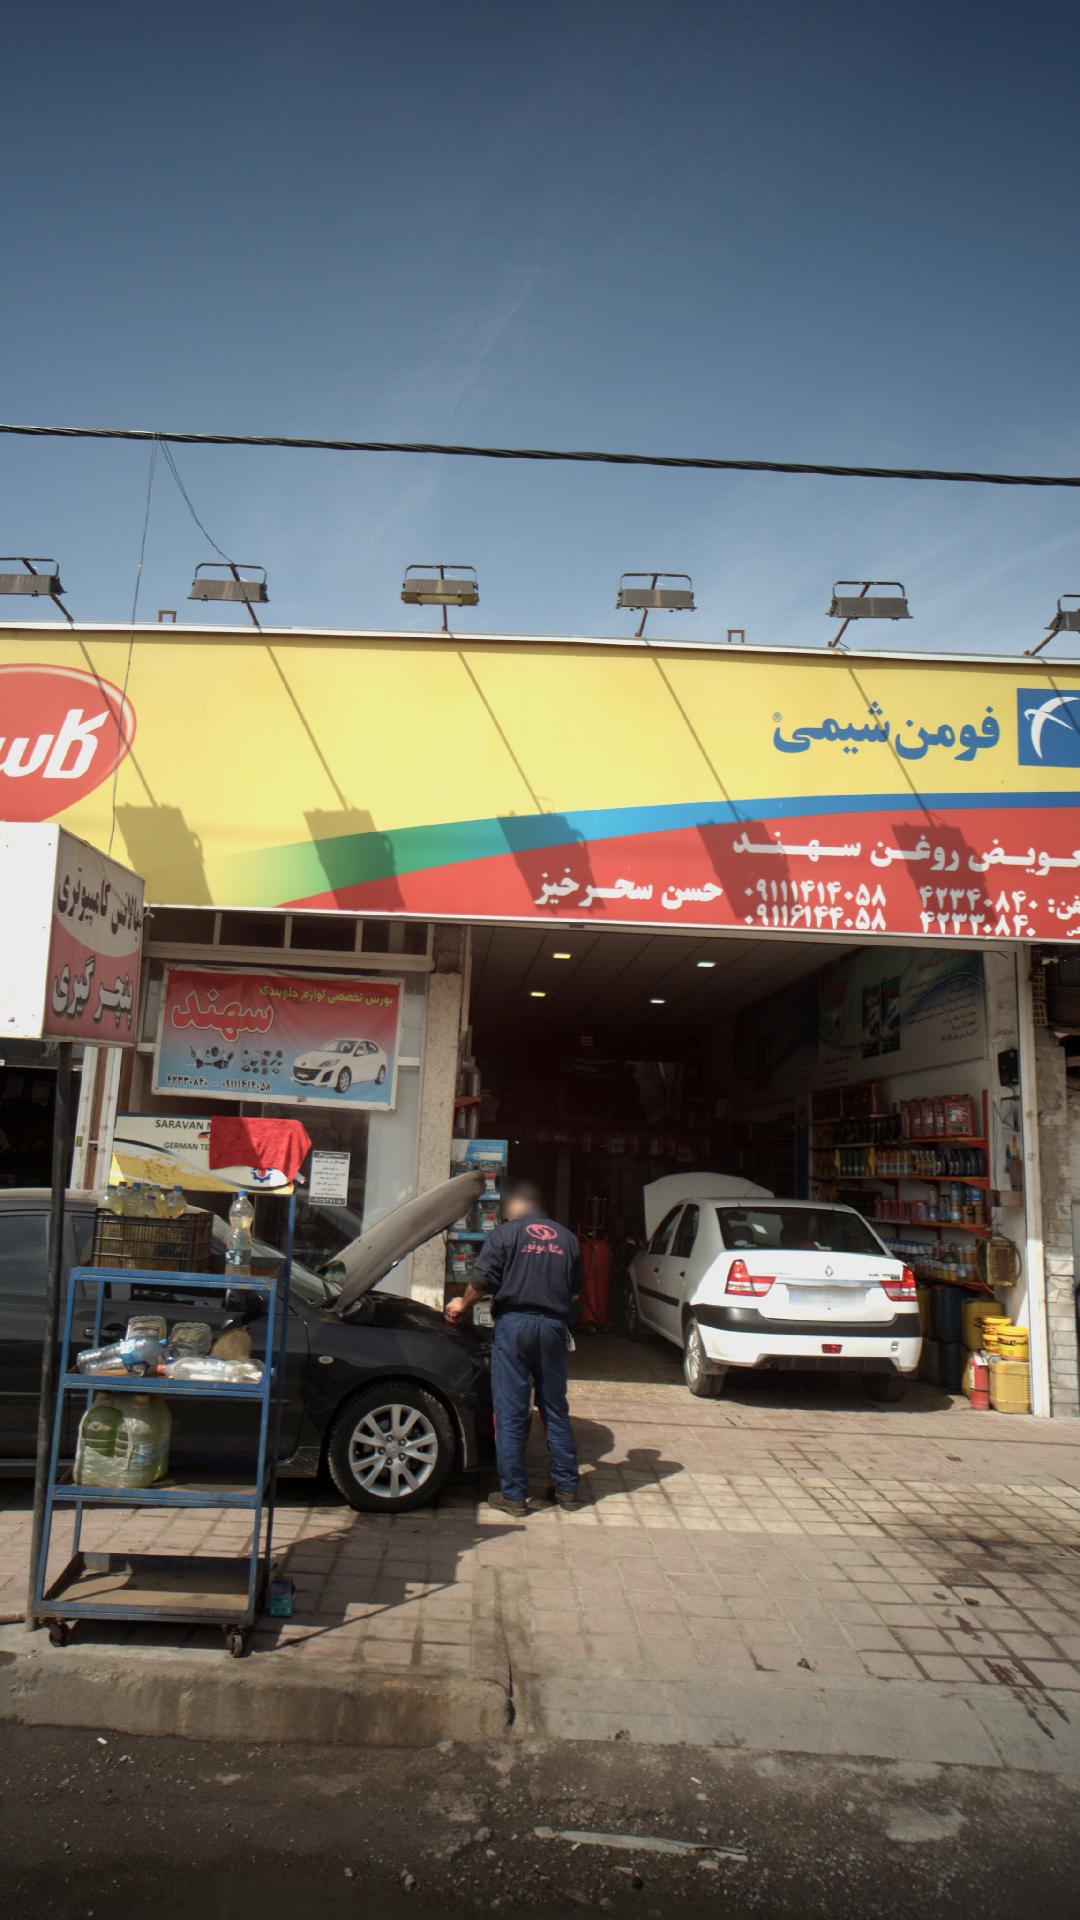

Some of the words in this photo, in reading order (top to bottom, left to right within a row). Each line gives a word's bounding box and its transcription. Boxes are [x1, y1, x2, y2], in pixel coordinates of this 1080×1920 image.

[773, 701, 890, 754] شیمی
[895, 706, 1000, 761] فومن
[733, 832, 861, 862] سهند
[870, 834, 960, 871] روغن
[661, 882, 724, 910] حسن
[744, 878, 887, 907] ۰۹۱۱۱۴۱۴۰۵۸
[919, 885, 1039, 913] ۴۲۳۴۰۸۴۰
[744, 903, 887, 930] ۰۹۱۱۶۱۴۴۰۵۸
[920, 911, 1036, 936] ۴۲۳۳۰۸۴۰
[52, 955, 96, 1016] گیری
[94, 973, 133, 1030] پنچر
[172, 989, 274, 1042] سهند
[155, 1119, 203, 1130] SARAVAN
[164, 1142, 198, 1150] GERMAN
